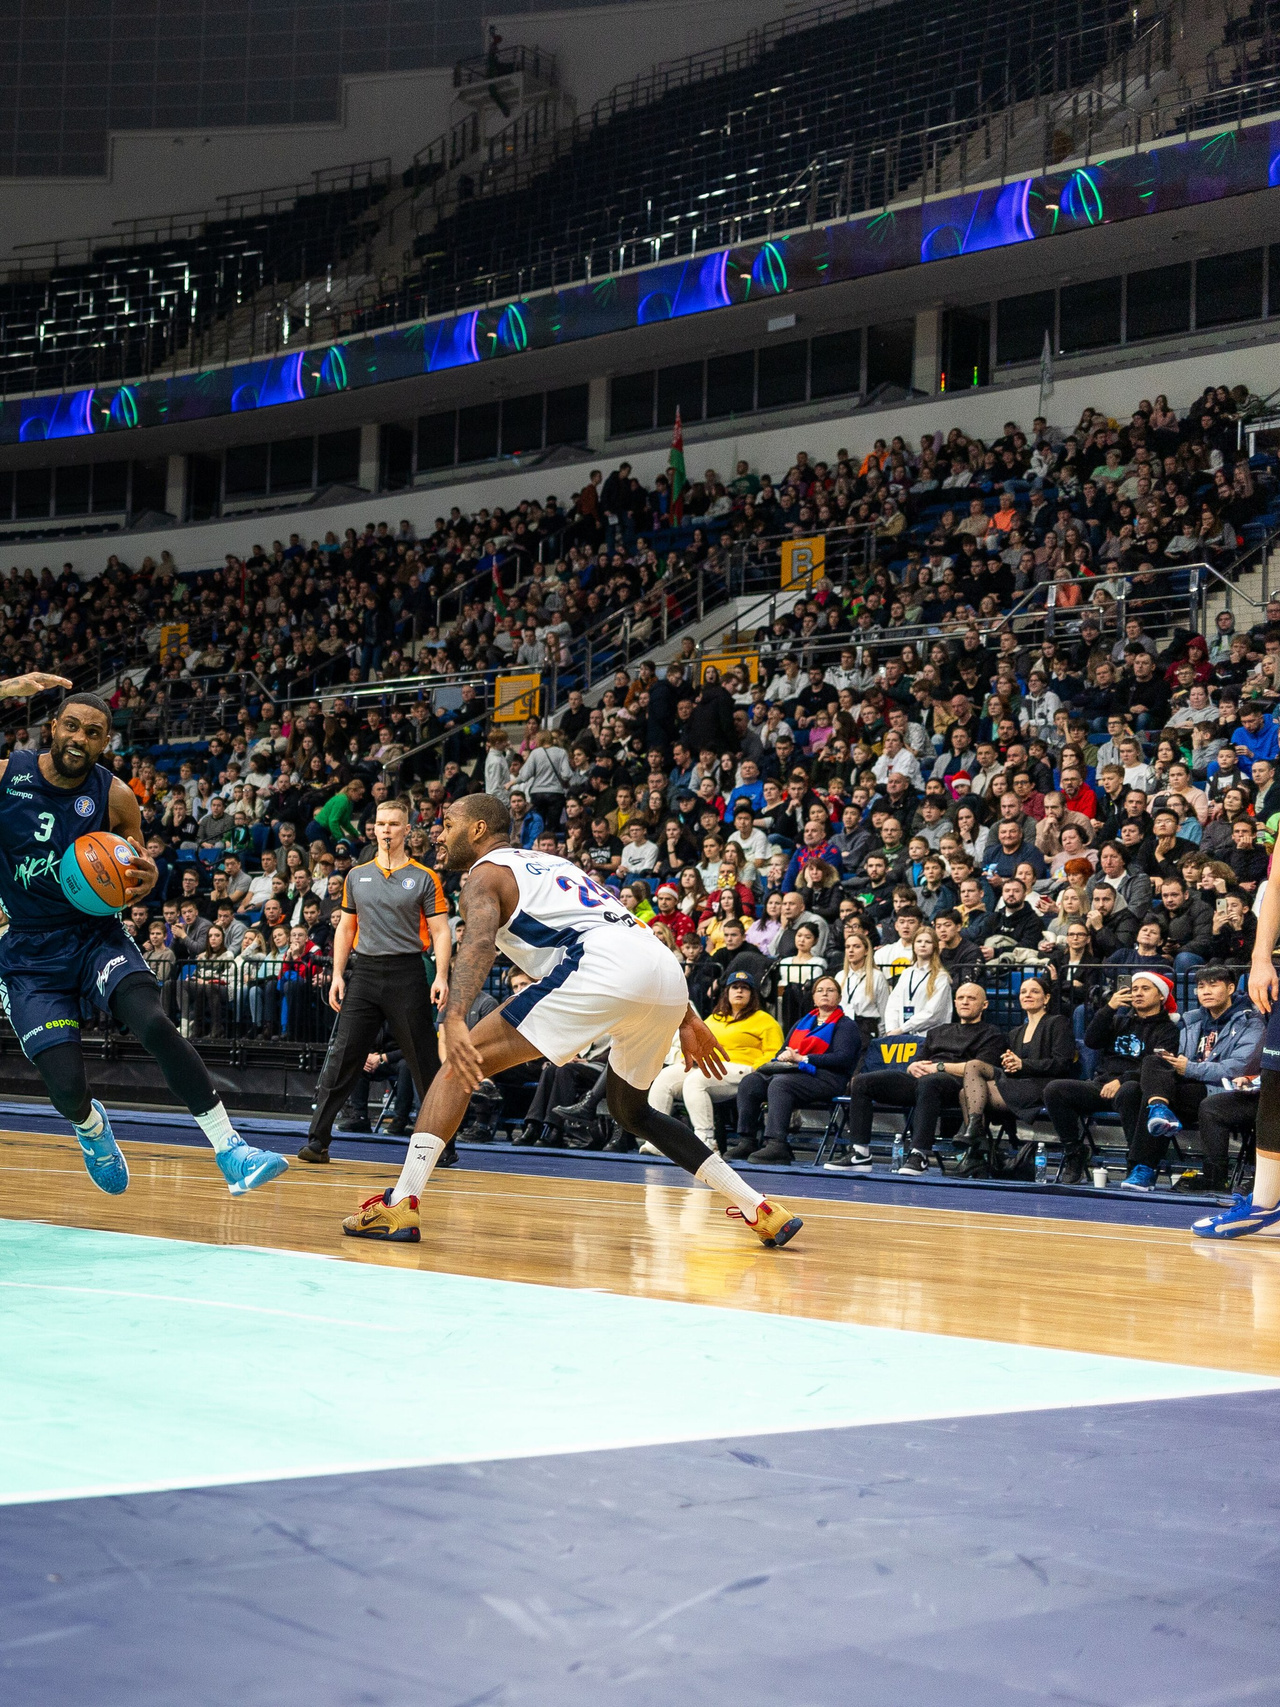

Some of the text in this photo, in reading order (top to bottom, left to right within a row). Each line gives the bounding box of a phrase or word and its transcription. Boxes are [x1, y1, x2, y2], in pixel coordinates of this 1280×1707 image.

[792, 548, 813, 580] B
[6, 787, 33, 800] Kempa
[34, 811, 55, 842] 3
[22, 1025, 44, 1043] Kempa
[880, 1042, 918, 1064] VIP
